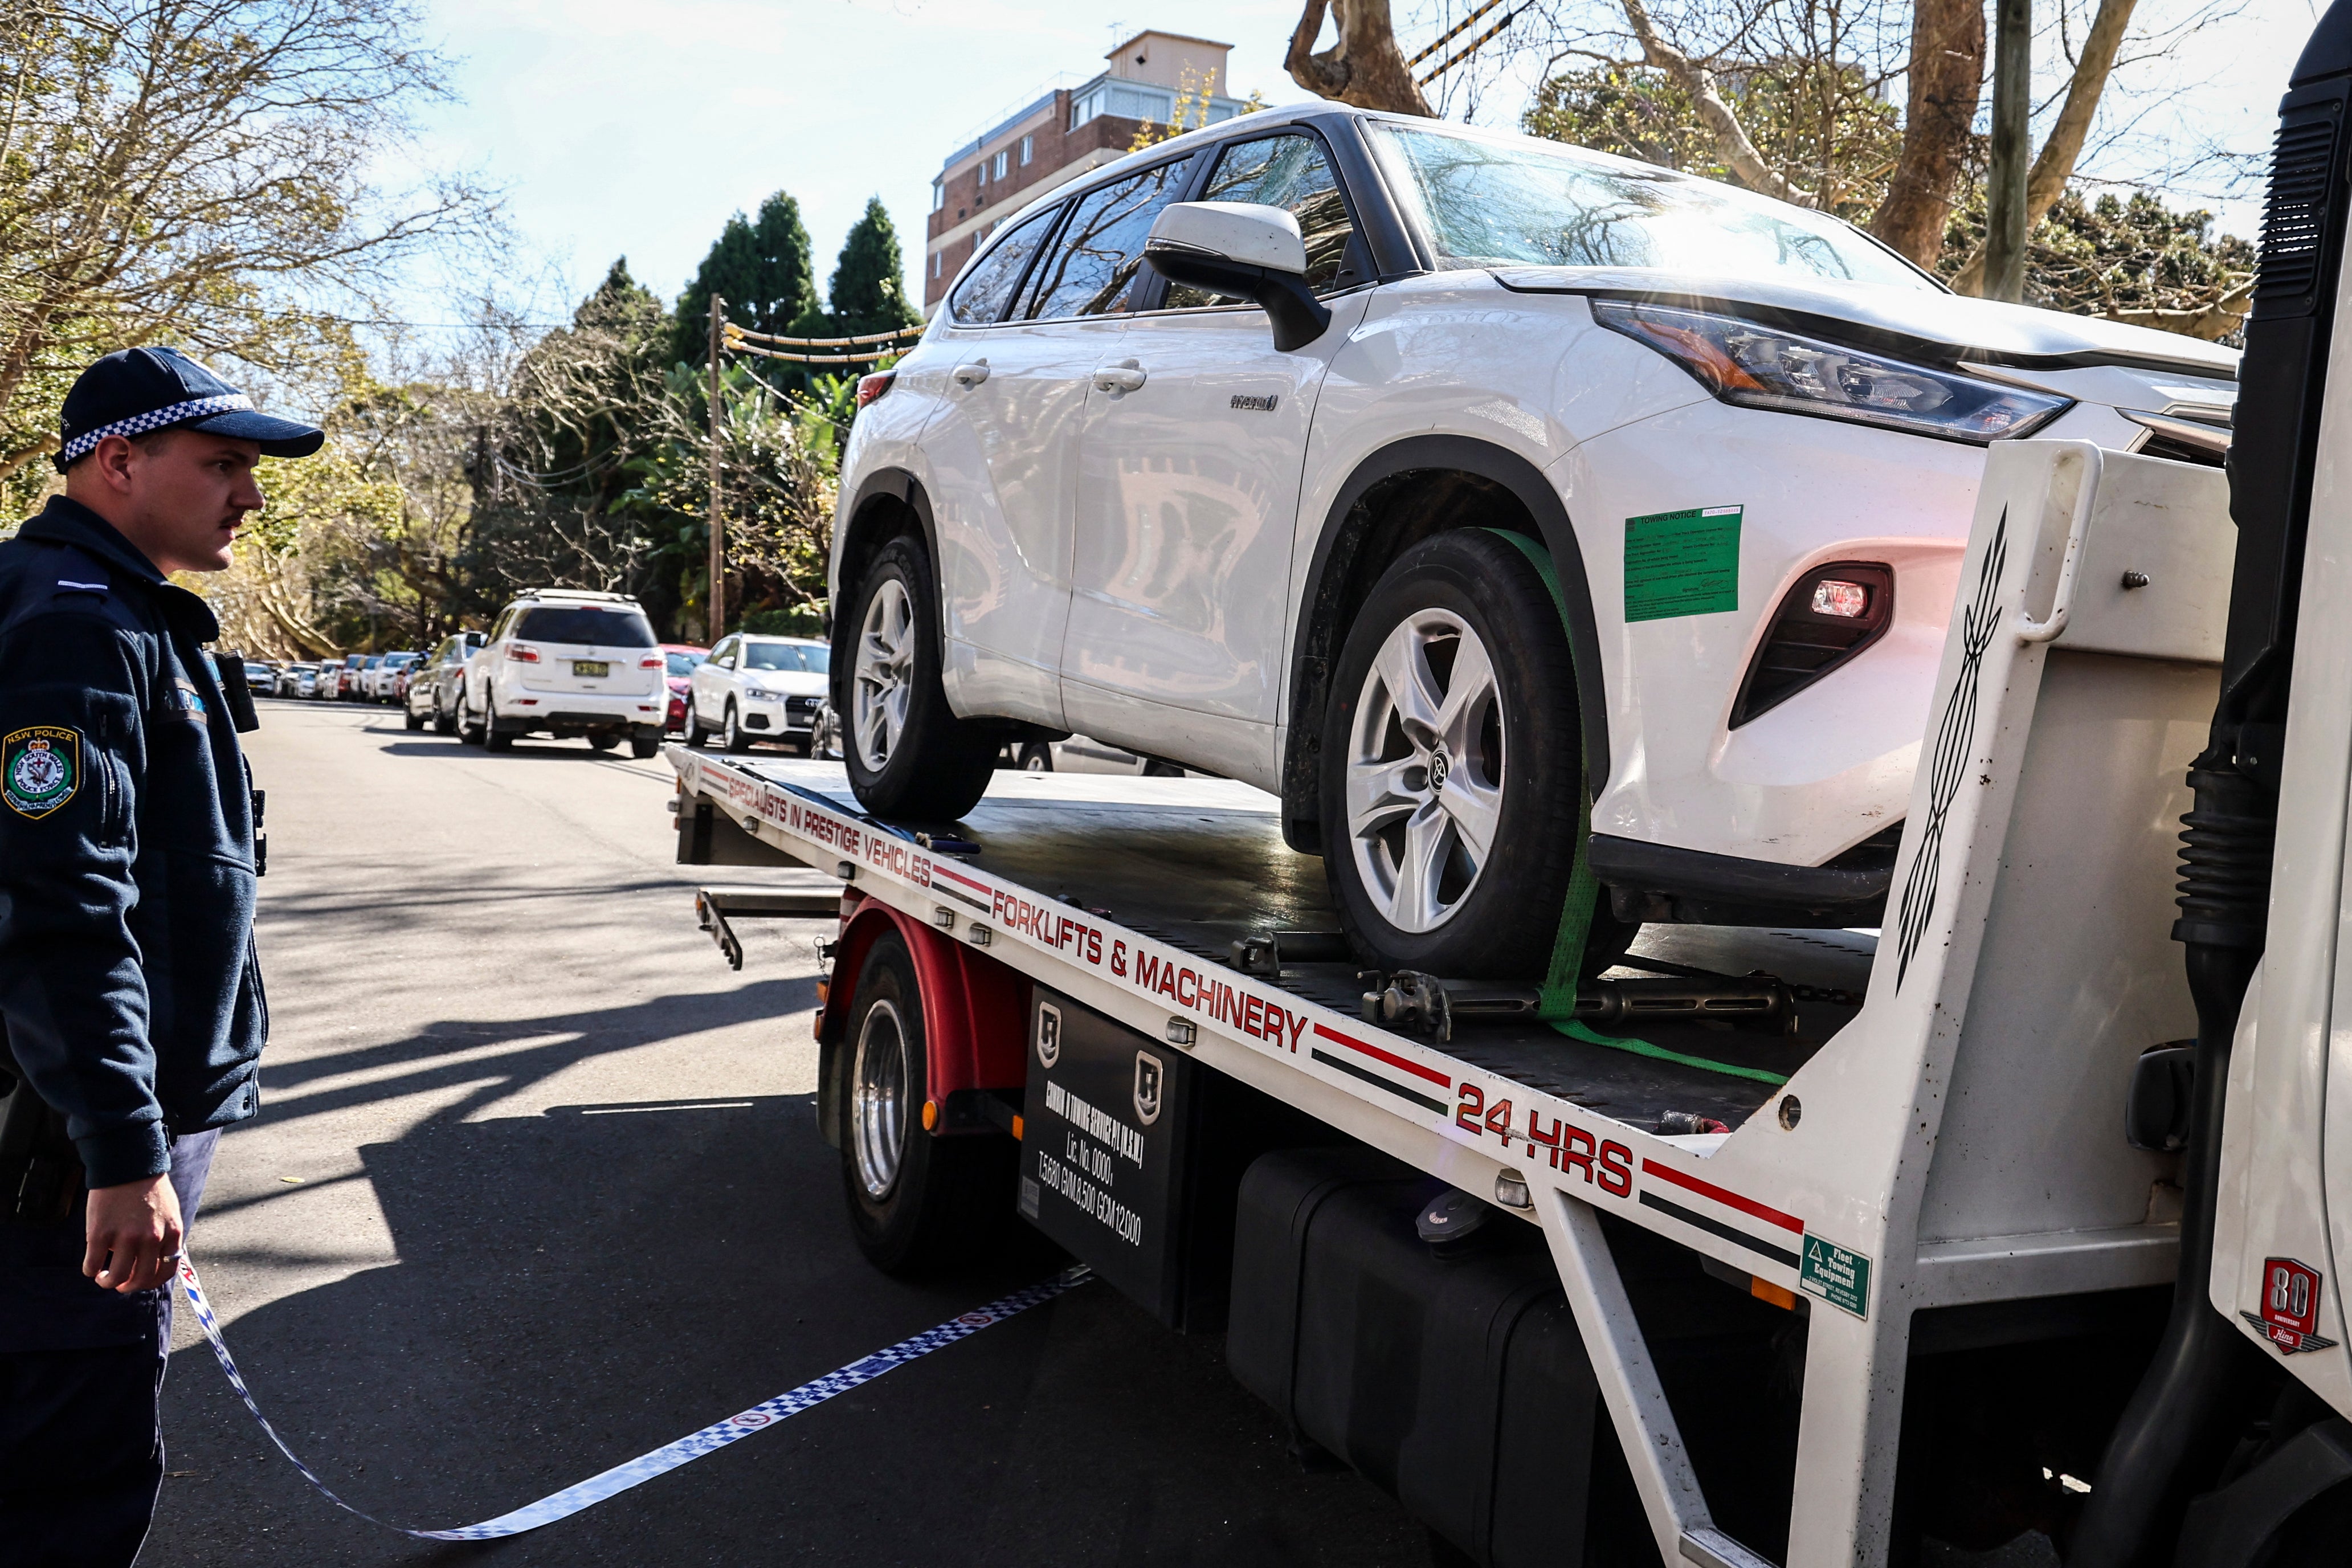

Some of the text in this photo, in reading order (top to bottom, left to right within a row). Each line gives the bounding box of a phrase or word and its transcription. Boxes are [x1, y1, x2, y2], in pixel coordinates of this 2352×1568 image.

[1641, 514, 1668, 524] TOWING
[1669, 511, 1696, 520] NOTICE
[35, 730, 73, 741] POLICE
[15, 753, 63, 775] NEW SOUTH WALES
[17, 777, 61, 792] POLICE FORCE
[728, 777, 1633, 1198] SPECIALISTS IN PRESTIGE VEHICLES FORKLIFTS & MACHINERY 24 HRS
[1070, 1095, 1091, 1132] TOWING
[1090, 1106, 1112, 1145] SERVICE
[1112, 1119, 1121, 1152] P/L
[1120, 1124, 1144, 1169] (N.S.W.)
[1067, 1131, 1077, 1163] Lic.
[1079, 1140, 1089, 1171] No.
[1833, 1247, 1853, 1265] Fleet
[1814, 1263, 1854, 1289] Equipment
[1828, 1256, 1855, 1280] Towing
[1811, 1276, 1823, 1285] VIOLET
[1831, 1293, 1842, 1302] PHONE
[2271, 1267, 2309, 1318] 80
[2275, 1314, 2300, 1328] ANNIVERSARY
[2273, 1329, 2294, 1343] Hino
[793, 1378, 847, 1403] POLICE
